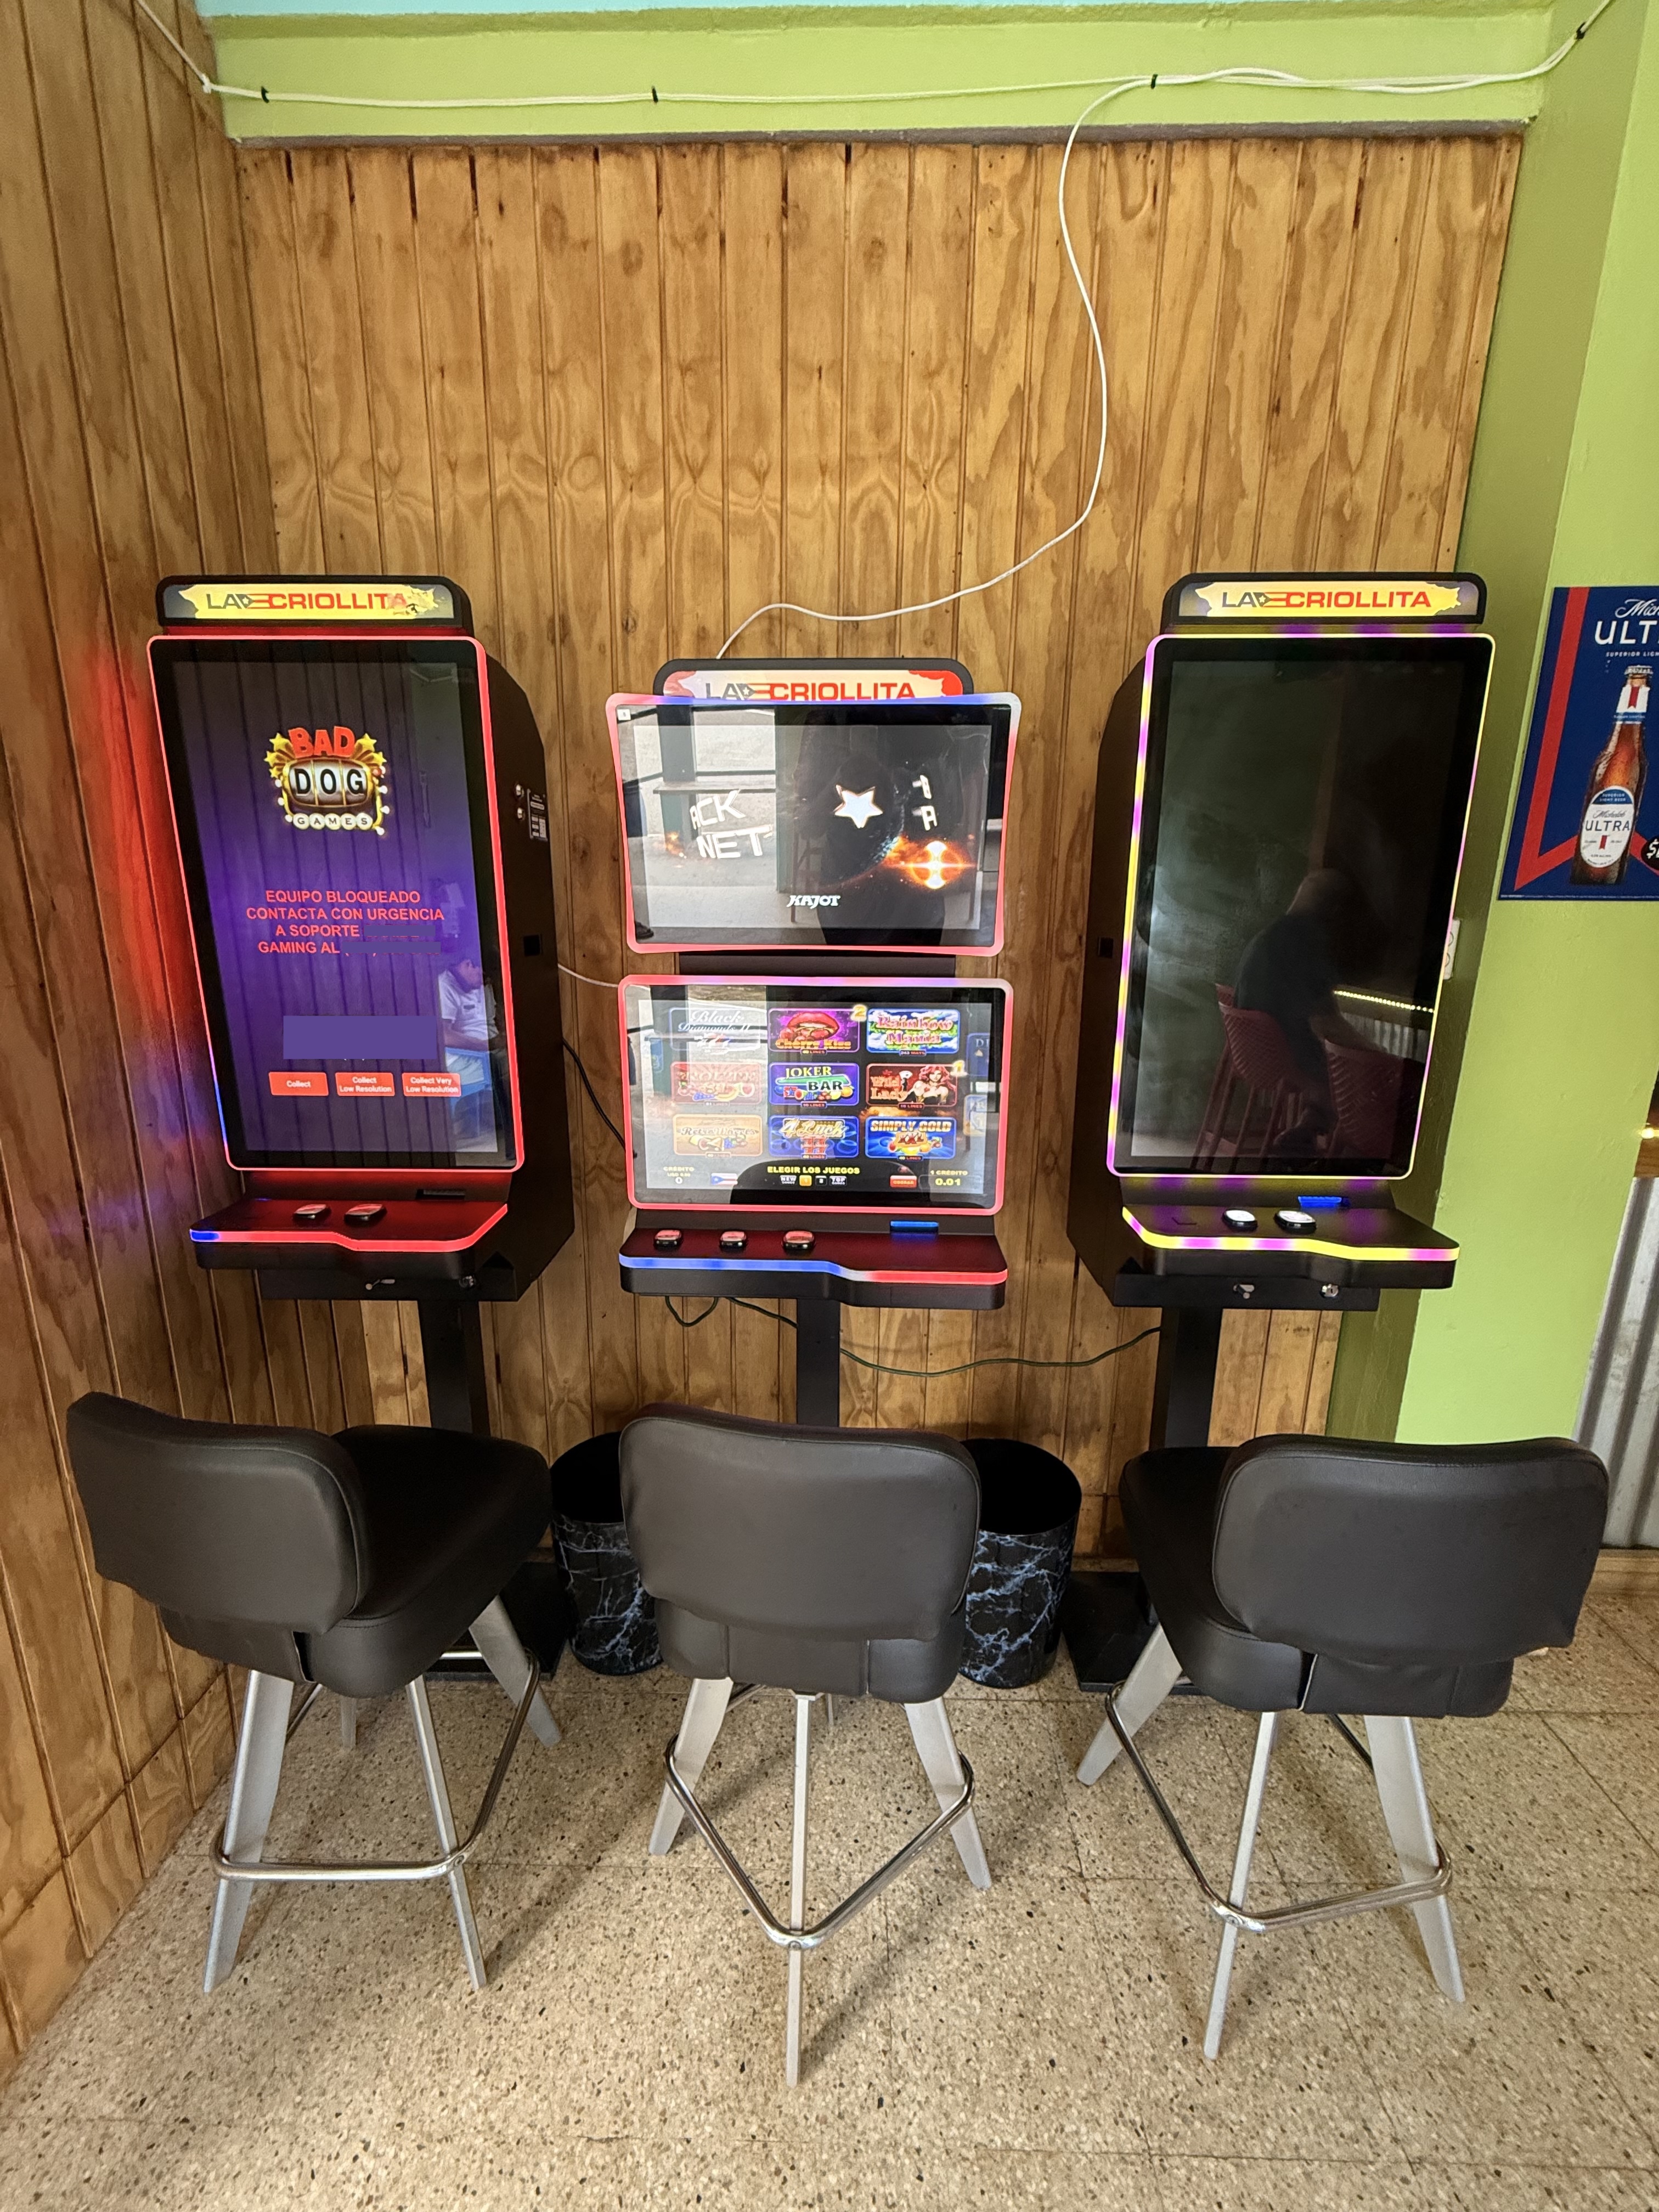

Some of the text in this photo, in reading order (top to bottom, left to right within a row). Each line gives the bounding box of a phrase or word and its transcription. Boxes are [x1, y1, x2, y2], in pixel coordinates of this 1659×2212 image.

[206, 593, 407, 609] LA CRIOLLITA
[1222, 591, 1431, 607] LA CRIOLLITA
[706, 682, 915, 701] LA CRIOLLITA
[289, 726, 356, 758] BAD
[295, 769, 364, 795] DOG
[297, 817, 367, 826] GAMES
[1585, 820, 1630, 831] ULTRA
[266, 890, 420, 904] EQUIPO BLOQUEADO
[786, 895, 841, 909] KAJOT
[247, 907, 444, 920] CONTACTA CON URGENCIA
[275, 926, 286, 936] A
[290, 925, 360, 936] SOPORTE
[258, 942, 317, 953] GAMING
[321, 942, 340, 953] AL
[690, 1011, 744, 1023] Black
[876, 1015, 953, 1030] Rainbow
[678, 1023, 736, 1031] Diamonds
[886, 1030, 941, 1045] Mania
[786, 1066, 832, 1079] JOKER
[437, 1077, 452, 1086] Very
[808, 1081, 843, 1091] BAR
[870, 1075, 900, 1087] Wild
[870, 1120, 952, 1132] SIMPLY GOLD
[898, 1132, 924, 1144] XXL
